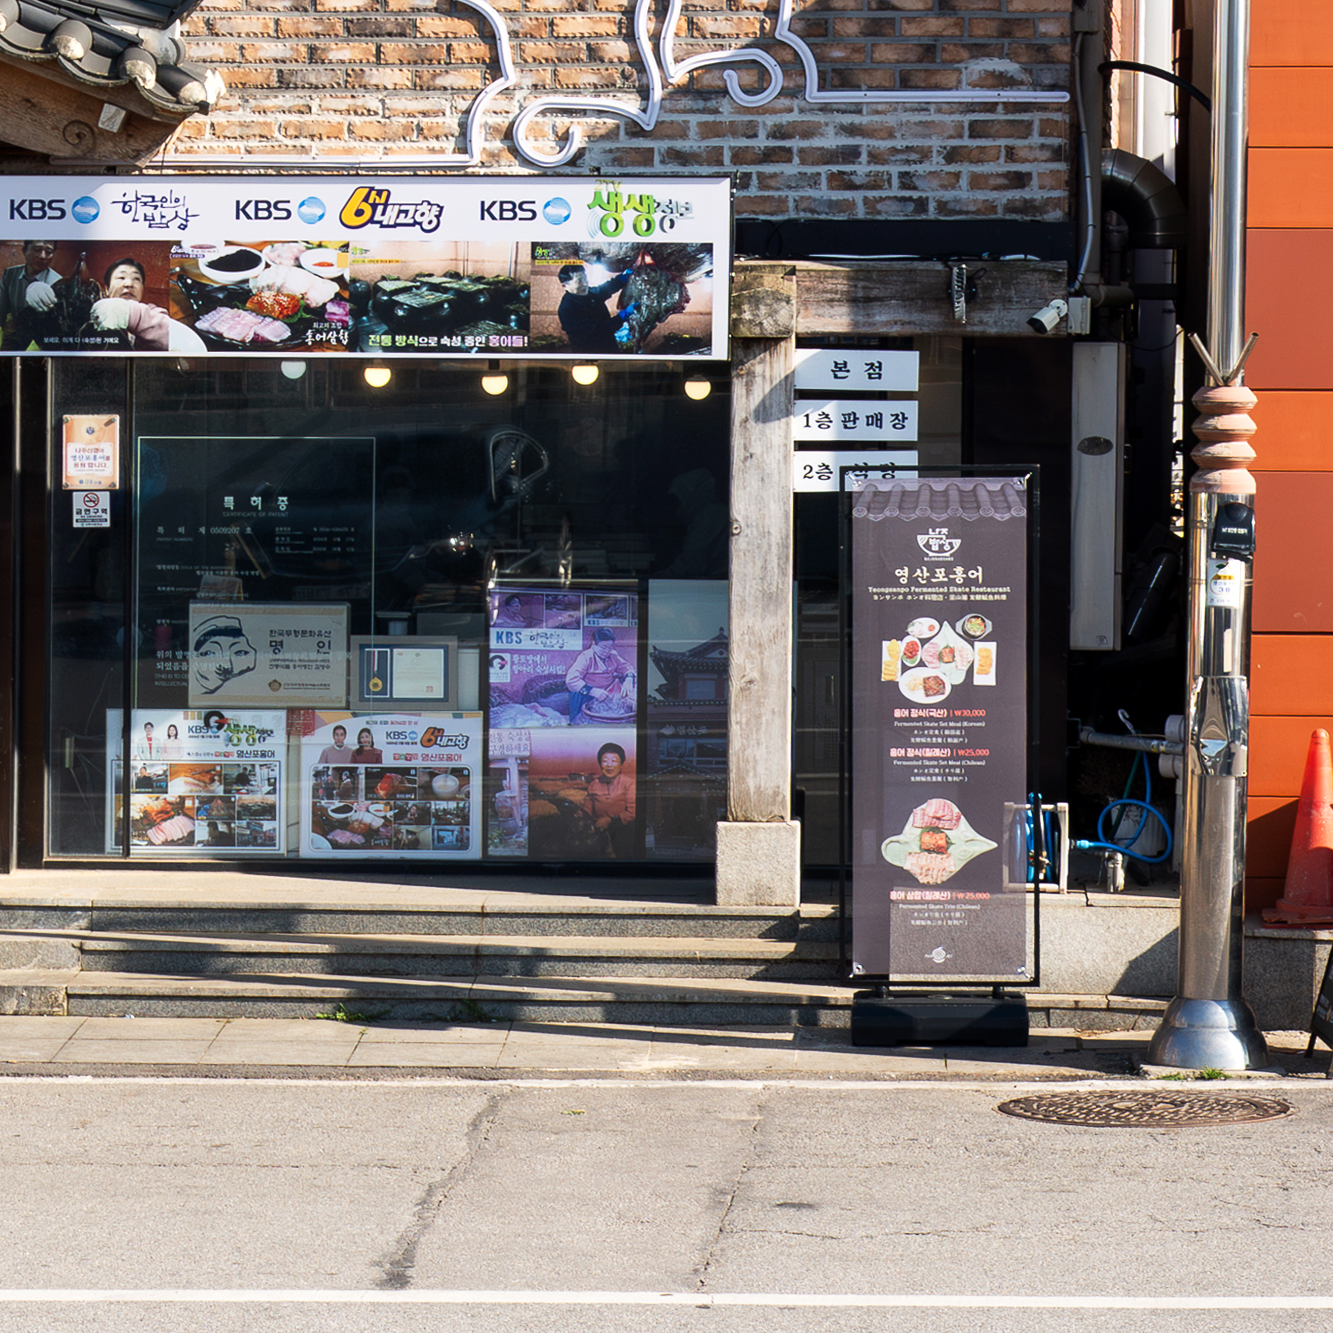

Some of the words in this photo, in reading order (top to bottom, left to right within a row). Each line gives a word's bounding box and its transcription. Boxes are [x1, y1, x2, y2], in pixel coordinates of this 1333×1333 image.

[8, 198, 67, 221] KBS
[110, 189, 187, 223] 한국인의
[234, 199, 292, 221] KBS
[479, 199, 537, 222] KBS
[142, 209, 201, 231] 밥상
[304, 329, 350, 346] 홍어삼합
[368, 334, 394, 348] 전통
[395, 334, 439, 348] 방식으로
[440, 335, 462, 348] 숙성
[464, 335, 487, 348] 중인
[488, 334, 529, 348] 홍어들!
[802, 462, 834, 482] 2층
[894, 565, 983, 585] 영산포홍어
[867, 586, 910, 594] Yeongsanpo
[268, 628, 332, 639] 한국무형문화유산
[495, 630, 523, 645] KBS
[893, 708, 909, 718] 홍어
[385, 730, 408, 740] KBS
[235, 749, 276, 759] 영산포홍어
[420, 752, 463, 762] 영산포홍어
[889, 747, 906, 758] 홍어
